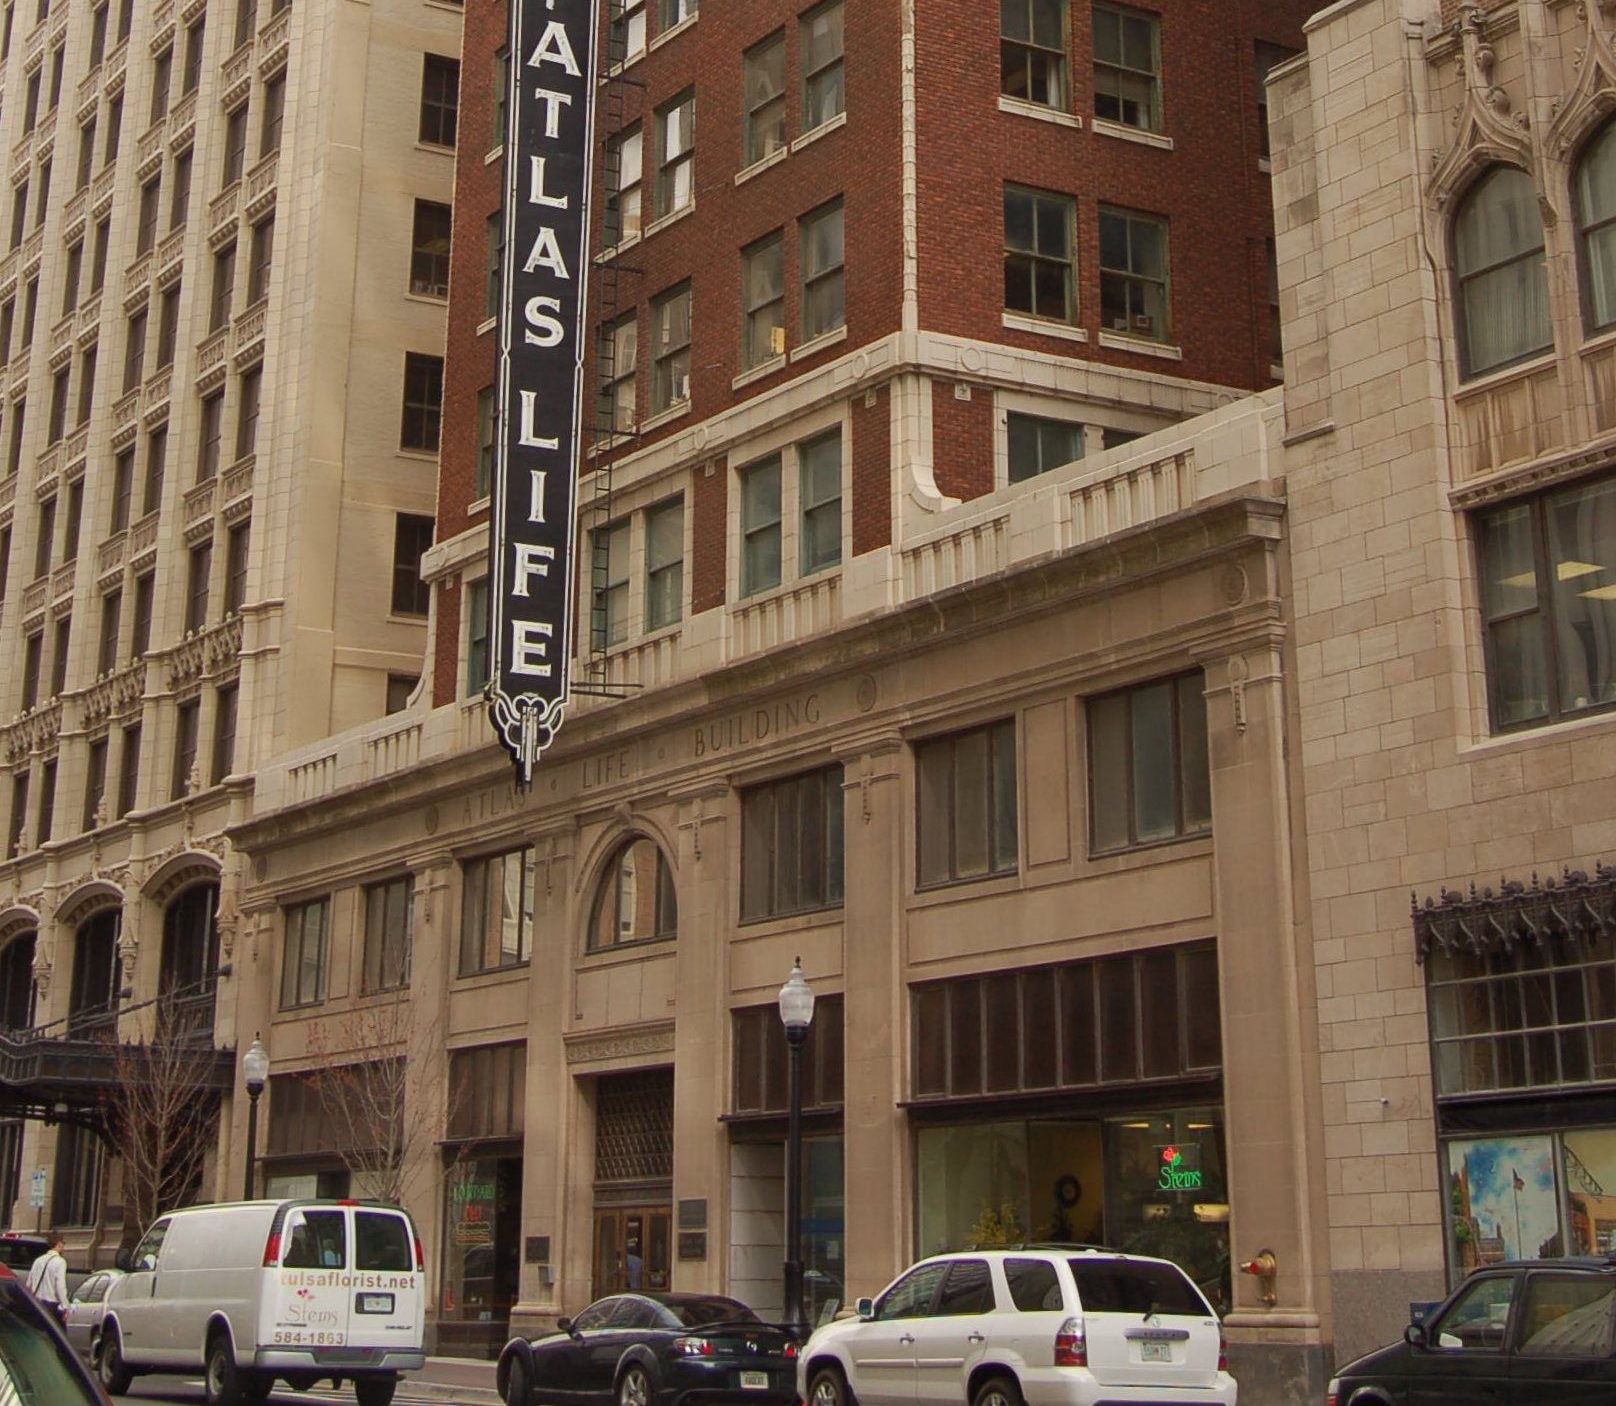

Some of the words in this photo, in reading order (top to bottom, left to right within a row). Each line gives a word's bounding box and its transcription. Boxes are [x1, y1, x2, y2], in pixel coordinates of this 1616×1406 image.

[515, 20, 582, 347] ATLAS
[509, 390, 559, 677] LIFE
[461, 783, 527, 825] ATLAS
[582, 750, 629, 790] LIFE
[694, 694, 820, 759] BUILDING
[1158, 1164, 1201, 1189] Stems
[280, 1272, 416, 1289] tulsaflorist.net
[284, 1304, 338, 1325] Stems
[274, 1331, 344, 1345] 584-1863
